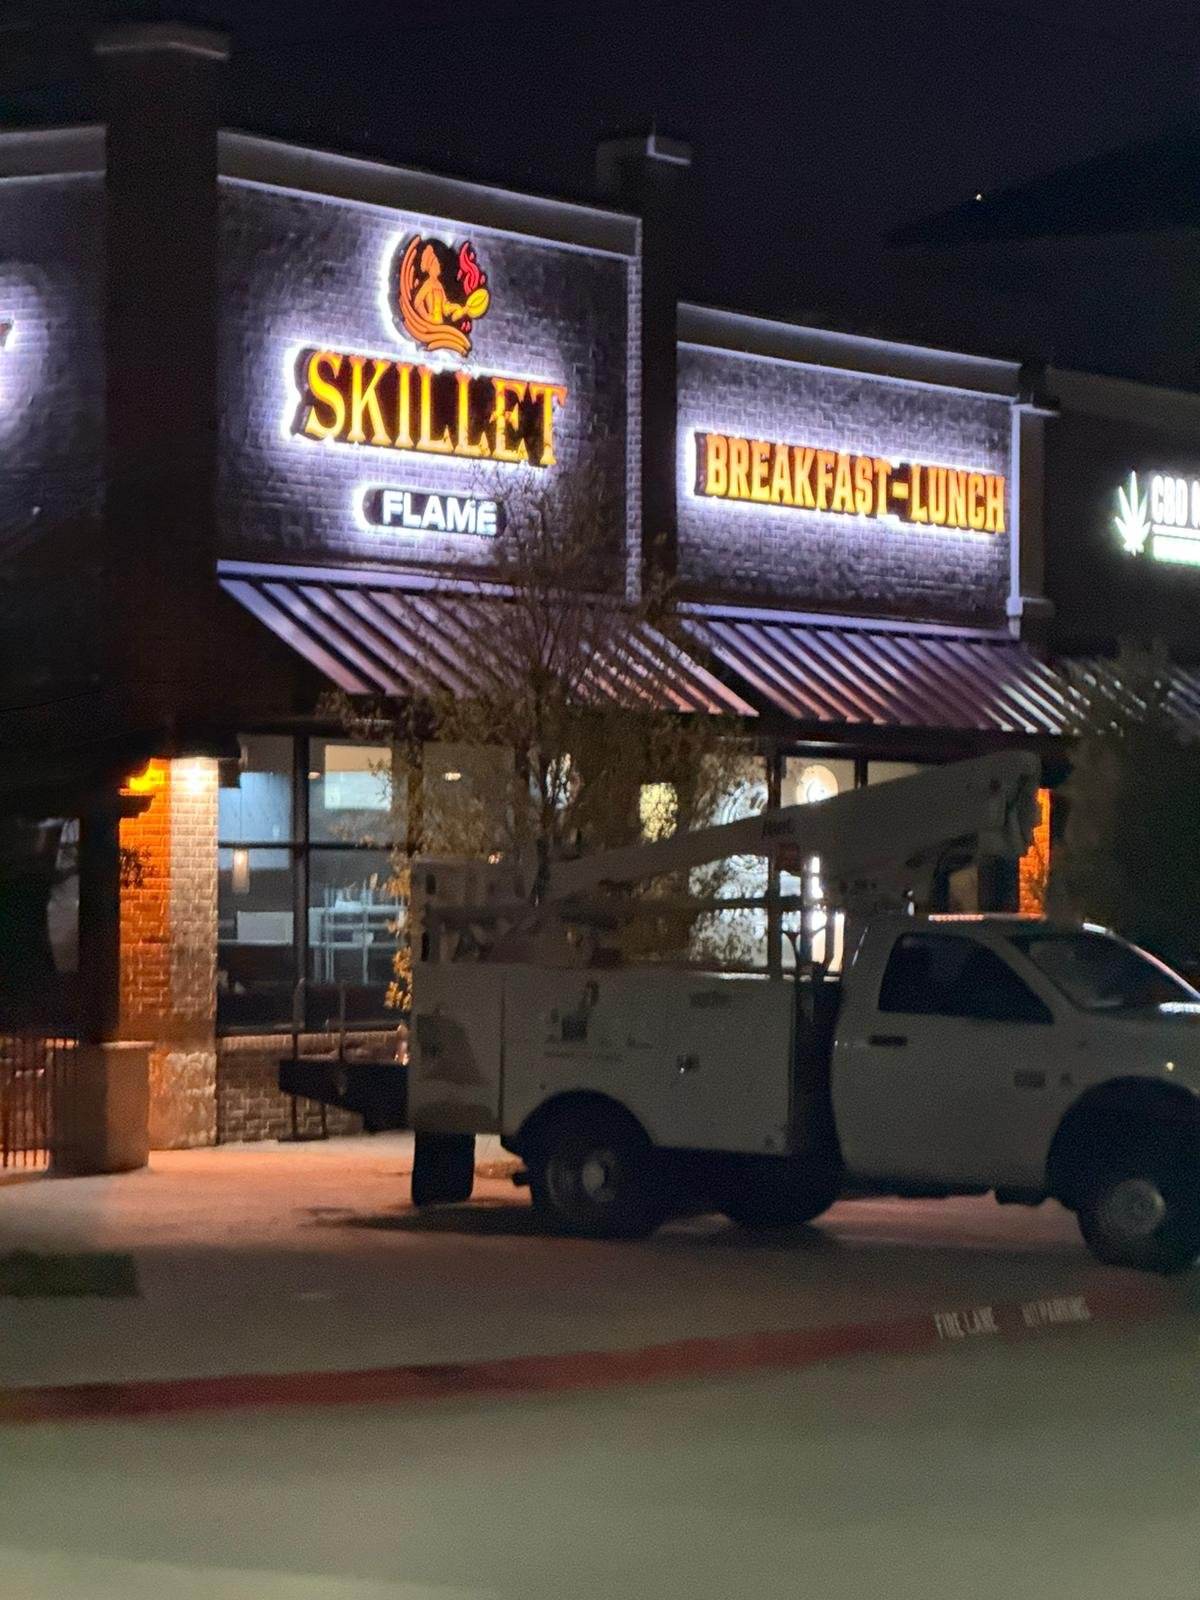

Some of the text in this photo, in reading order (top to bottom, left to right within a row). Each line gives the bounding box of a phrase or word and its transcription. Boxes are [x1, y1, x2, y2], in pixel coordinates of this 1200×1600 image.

[305, 349, 568, 466] SKILLET
[382, 490, 497, 536] FLAME
[705, 433, 1006, 533] BREAKFAST-LUNCH
[1151, 475, 1189, 528] CBD
